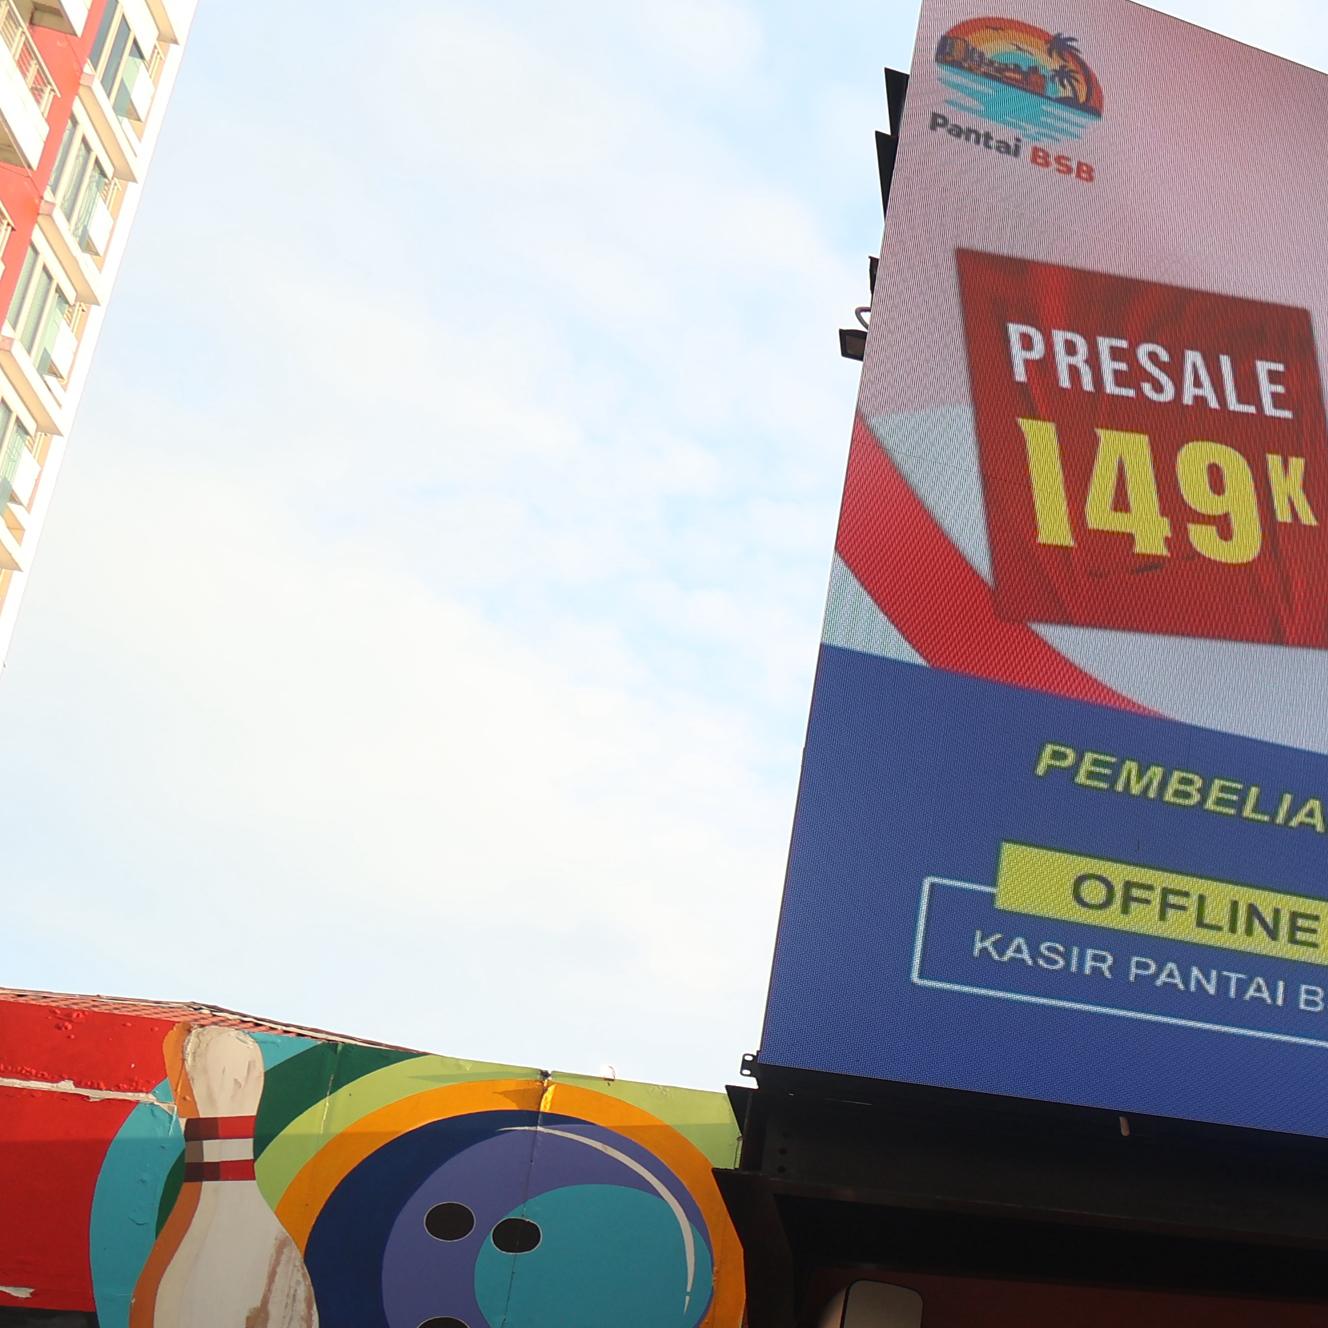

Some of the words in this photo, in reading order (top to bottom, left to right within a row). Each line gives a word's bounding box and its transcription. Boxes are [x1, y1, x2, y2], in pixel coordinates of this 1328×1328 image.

[930, 112, 1022, 160] Pantai
[1030, 146, 1096, 183] BSB
[1006, 322, 1294, 420] PRESALE
[1018, 417, 1318, 564] 149K
[1072, 871, 1321, 950] OFFLINE
[972, 930, 1115, 980] KASIR
[1128, 956, 1286, 1006] PANTAI
